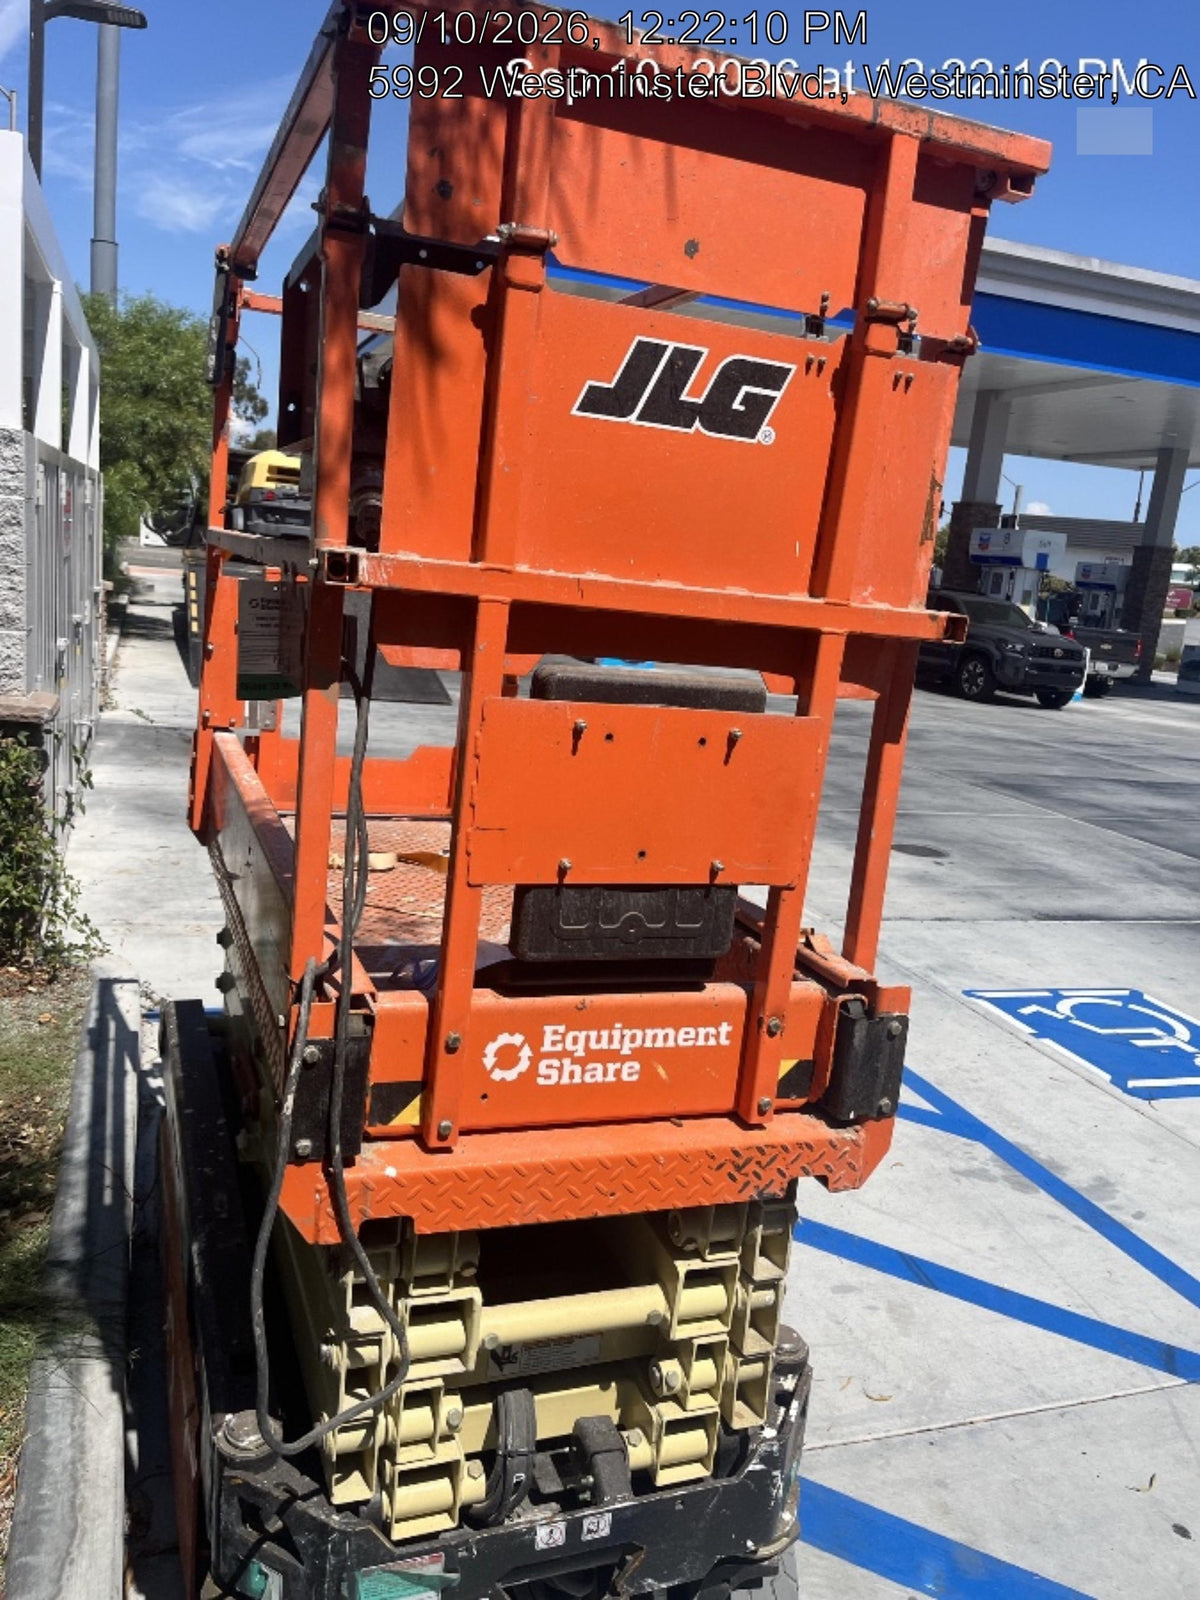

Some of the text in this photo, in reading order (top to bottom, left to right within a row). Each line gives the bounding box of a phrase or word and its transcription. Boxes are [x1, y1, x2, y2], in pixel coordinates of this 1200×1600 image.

[570, 335, 797, 443] JLG
[540, 1022, 732, 1057] Equipment
[536, 1057, 641, 1086] Share
